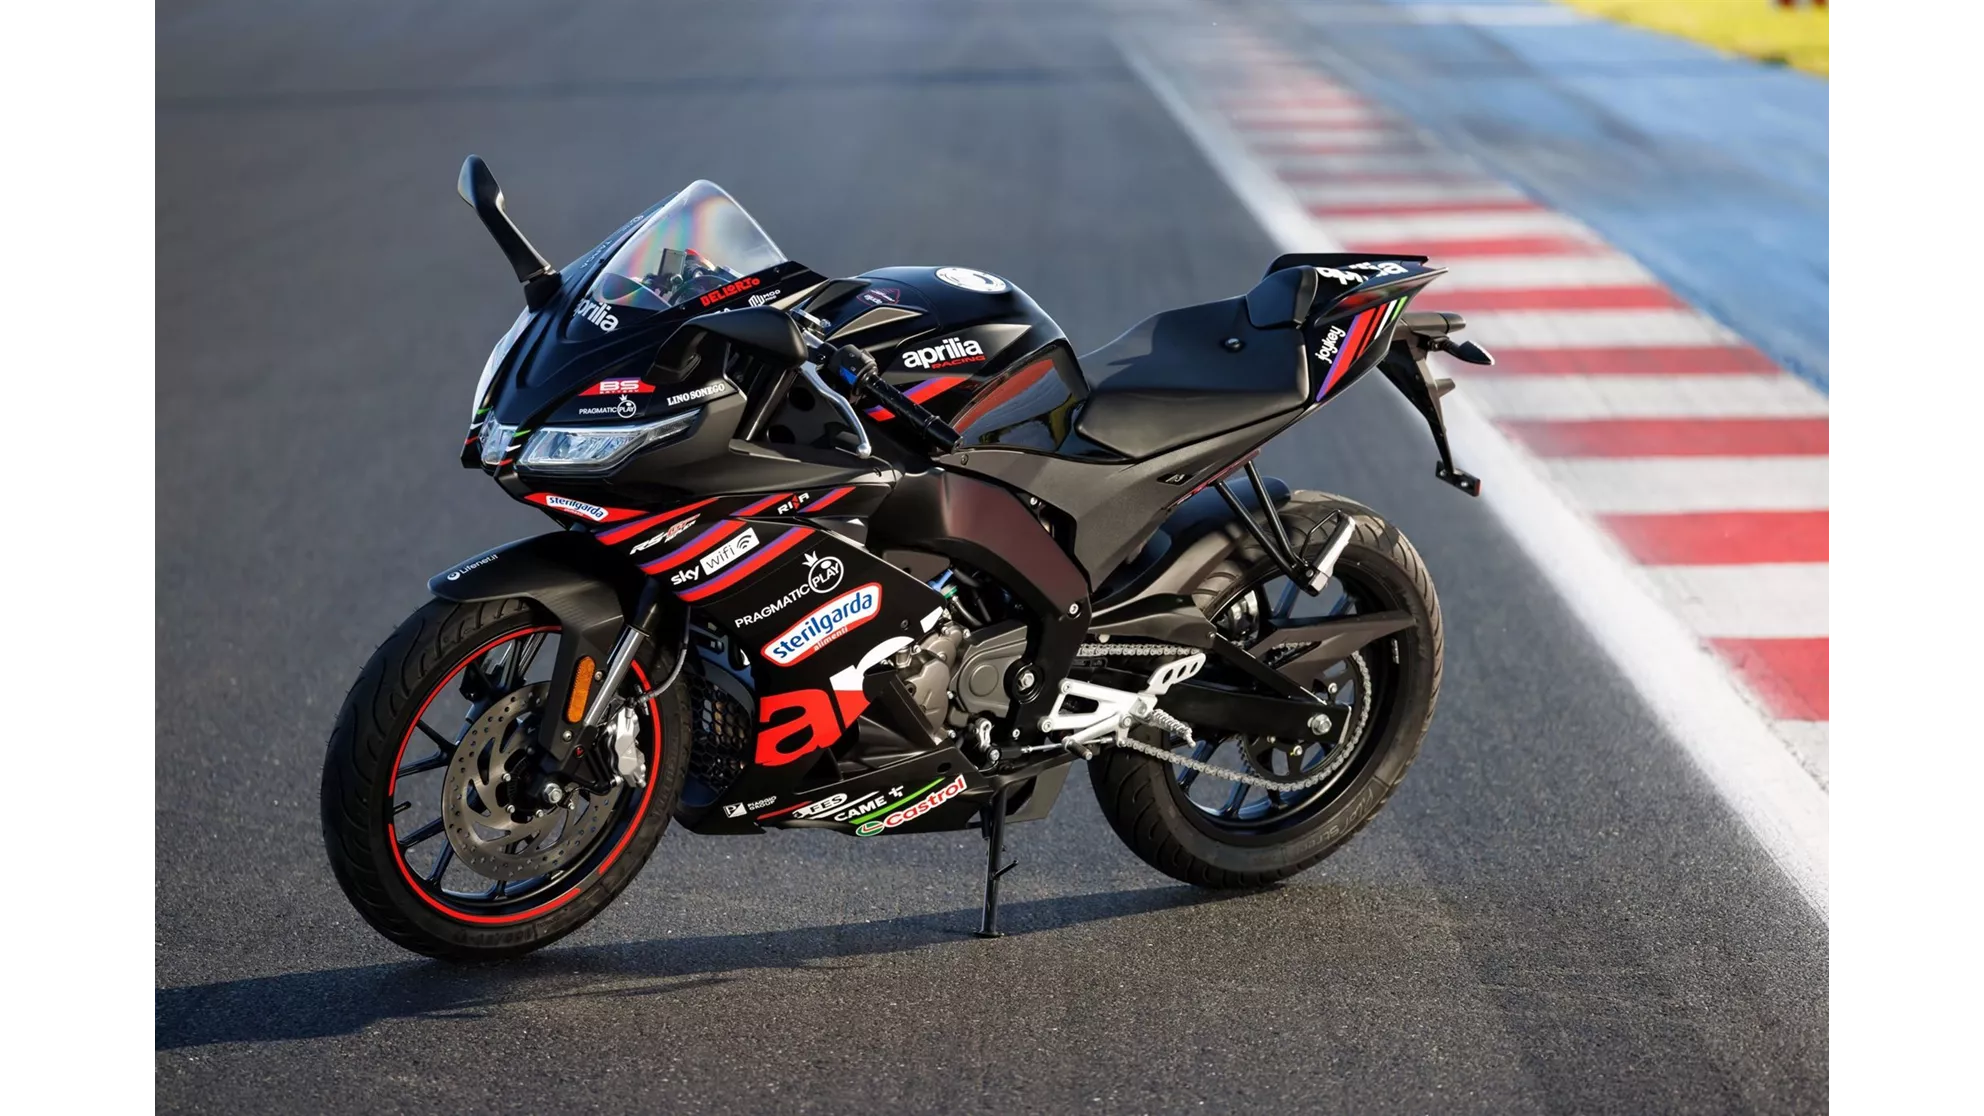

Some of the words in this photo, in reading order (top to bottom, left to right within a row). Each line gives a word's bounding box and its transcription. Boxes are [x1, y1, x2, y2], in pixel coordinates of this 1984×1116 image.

[902, 337, 983, 369] aprilia
[1315, 325, 1346, 364] joykey
[931, 355, 986, 370] RACING
[600, 380, 639, 391] BS
[667, 391, 691, 406] LINO
[690, 383, 726, 400] SONEGO
[579, 406, 618, 415] PRAGMATIC
[618, 405, 635, 414] PLAY
[549, 496, 604, 519] sterilgarda
[670, 565, 700, 585] sky
[706, 544, 735, 569] wifi
[735, 584, 811, 628] PRAGMATIC
[811, 563, 841, 588] PLAY
[773, 592, 873, 658] sterilgarda
[813, 626, 849, 652] alimenti
[747, 795, 777, 808] PIAGGIO
[748, 800, 775, 811] GROUP
[834, 797, 888, 822] CAME
[886, 776, 966, 827] Castrol
